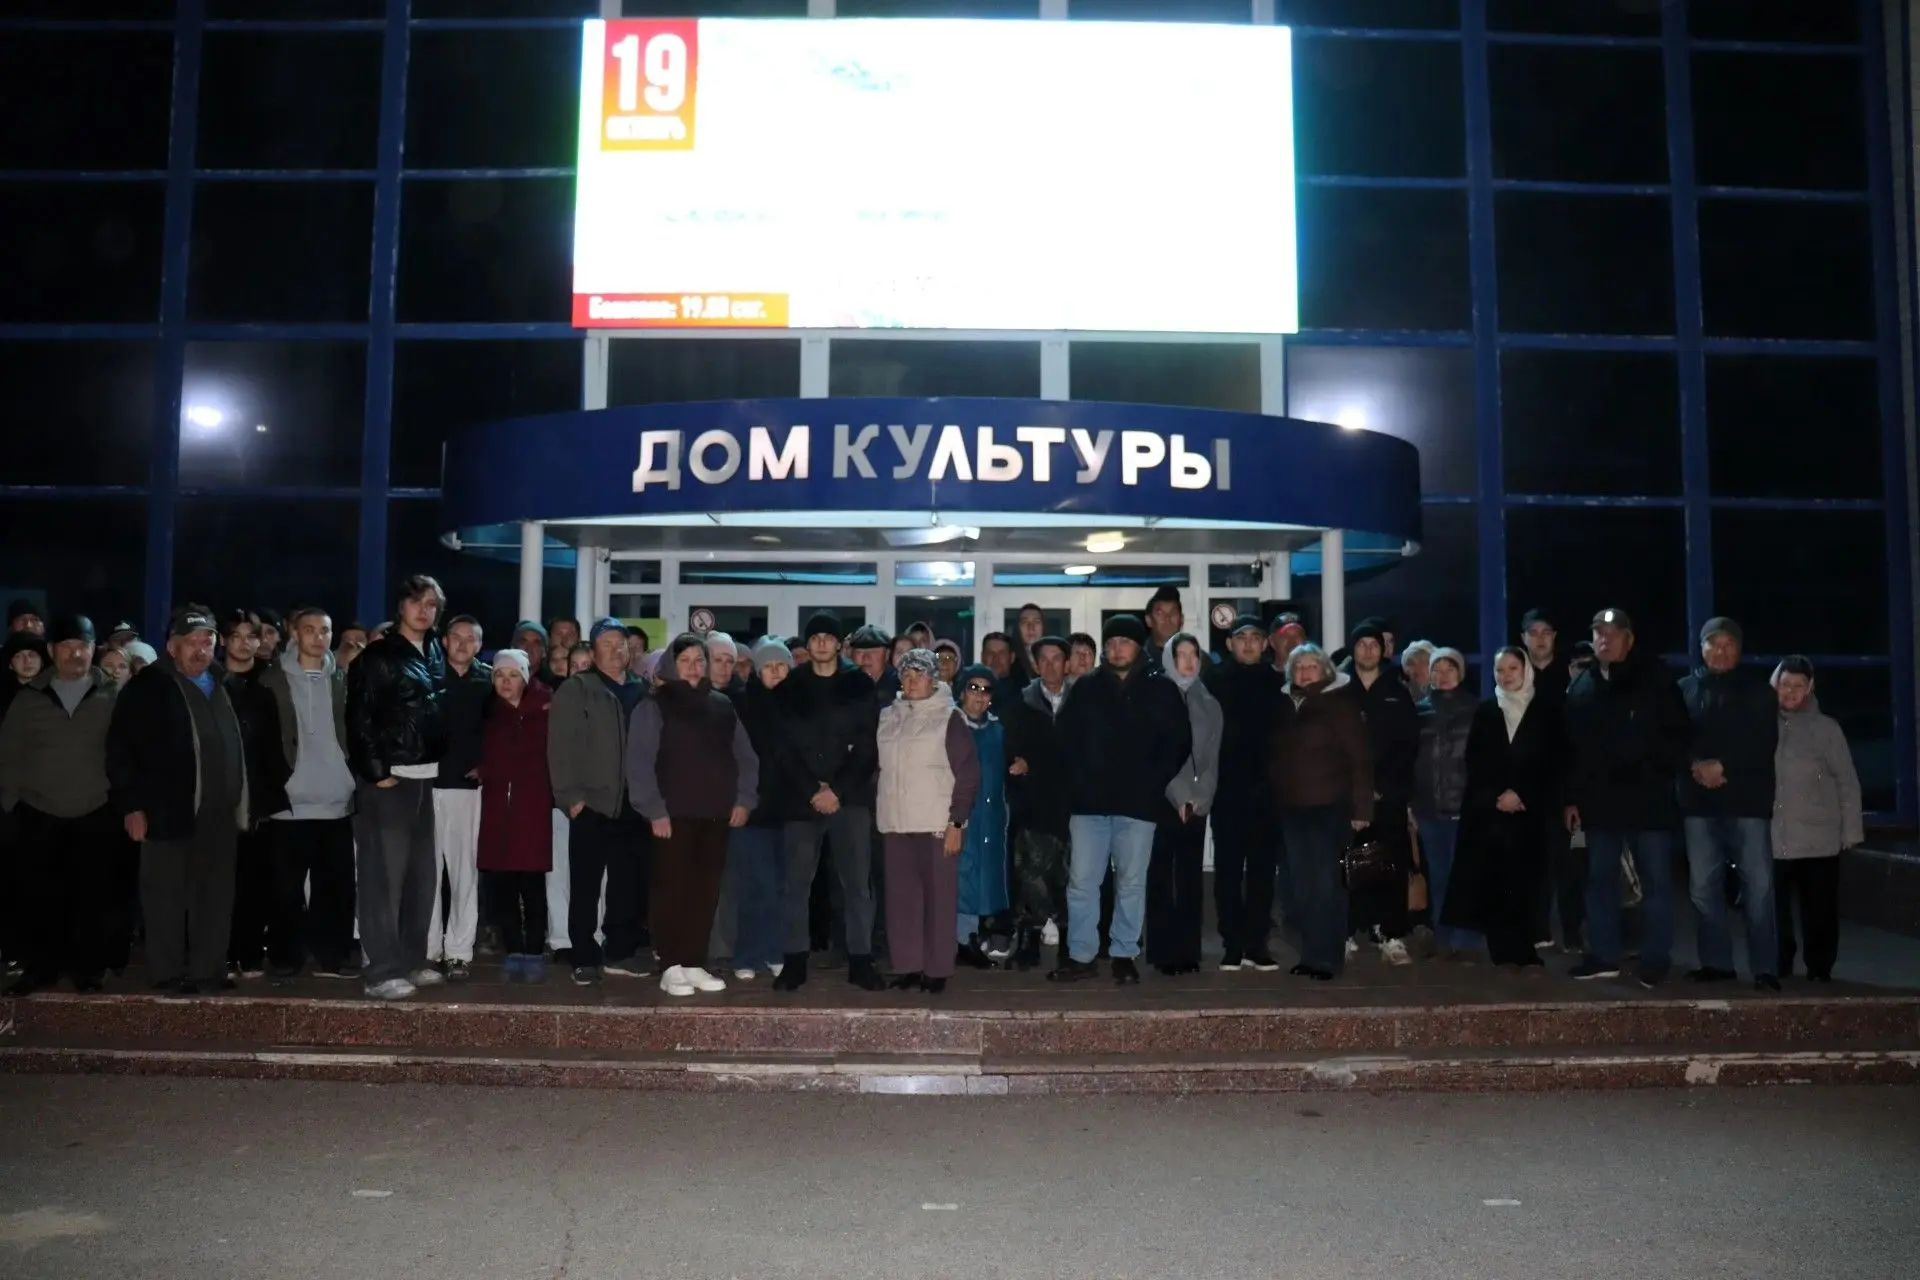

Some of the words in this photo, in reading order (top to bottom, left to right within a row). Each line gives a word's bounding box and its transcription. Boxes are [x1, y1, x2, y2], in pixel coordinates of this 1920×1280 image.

[611, 32, 687, 112] 19
[680, 296, 730, 319] 19.
[632, 425, 811, 493] ДОМ
[832, 423, 1232, 492] КУЛЬТУРЫ
